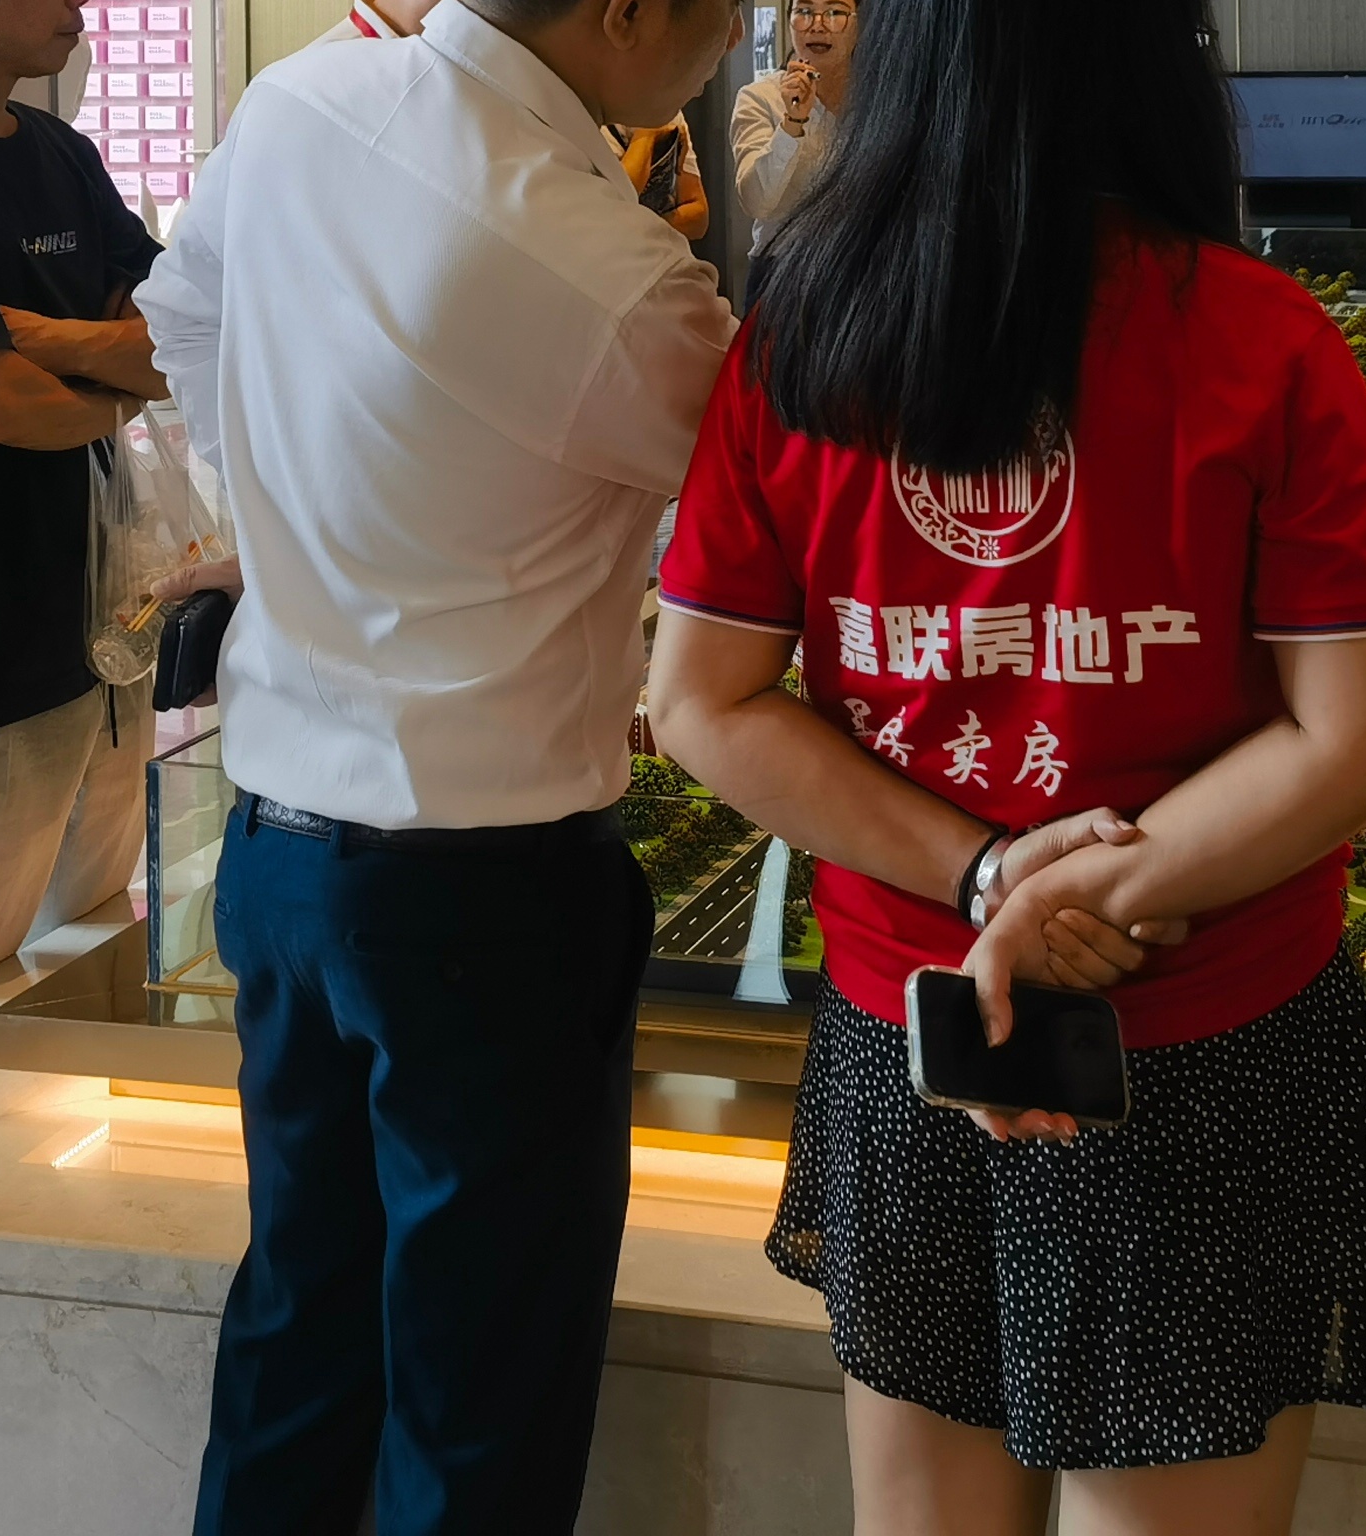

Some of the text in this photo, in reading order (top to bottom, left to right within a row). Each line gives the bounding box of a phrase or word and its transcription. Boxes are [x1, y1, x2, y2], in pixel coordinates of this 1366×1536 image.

[828, 596, 1201, 684] 嘉联房地产
